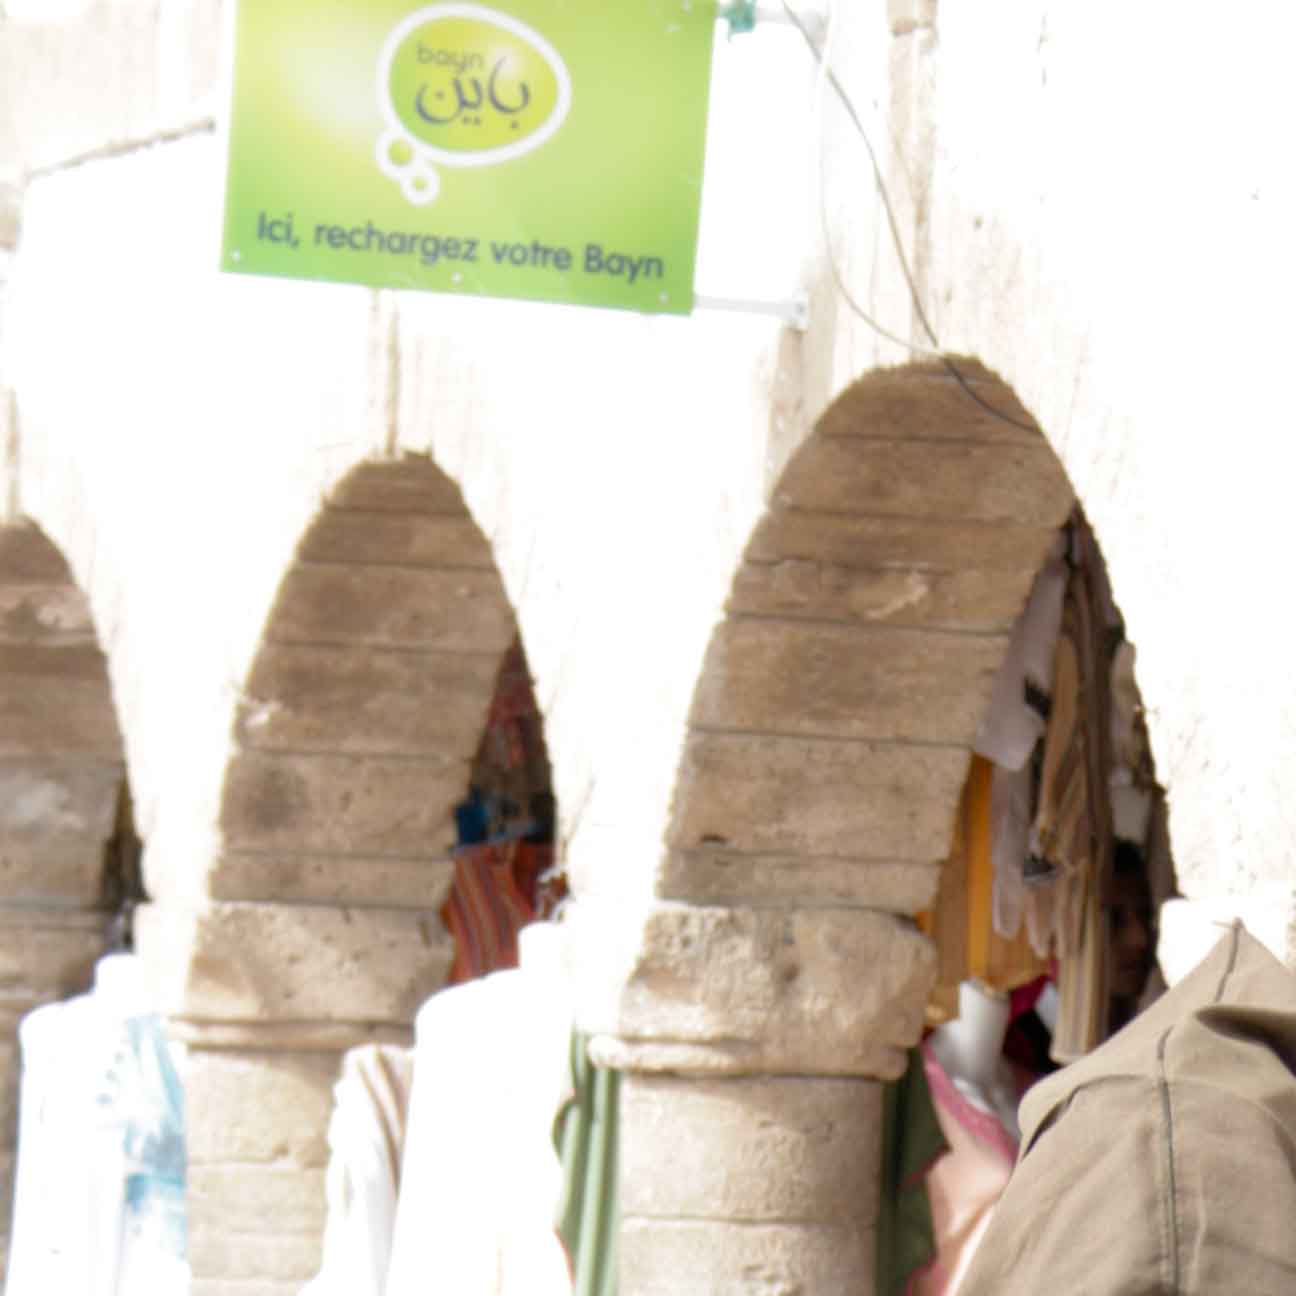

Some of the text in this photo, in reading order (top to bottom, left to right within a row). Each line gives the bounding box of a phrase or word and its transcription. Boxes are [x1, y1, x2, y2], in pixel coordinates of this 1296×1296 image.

[415, 56, 530, 130] باين
[416, 43, 485, 73] bayn
[256, 211, 664, 283] Ici, rechargez votre Bayn
